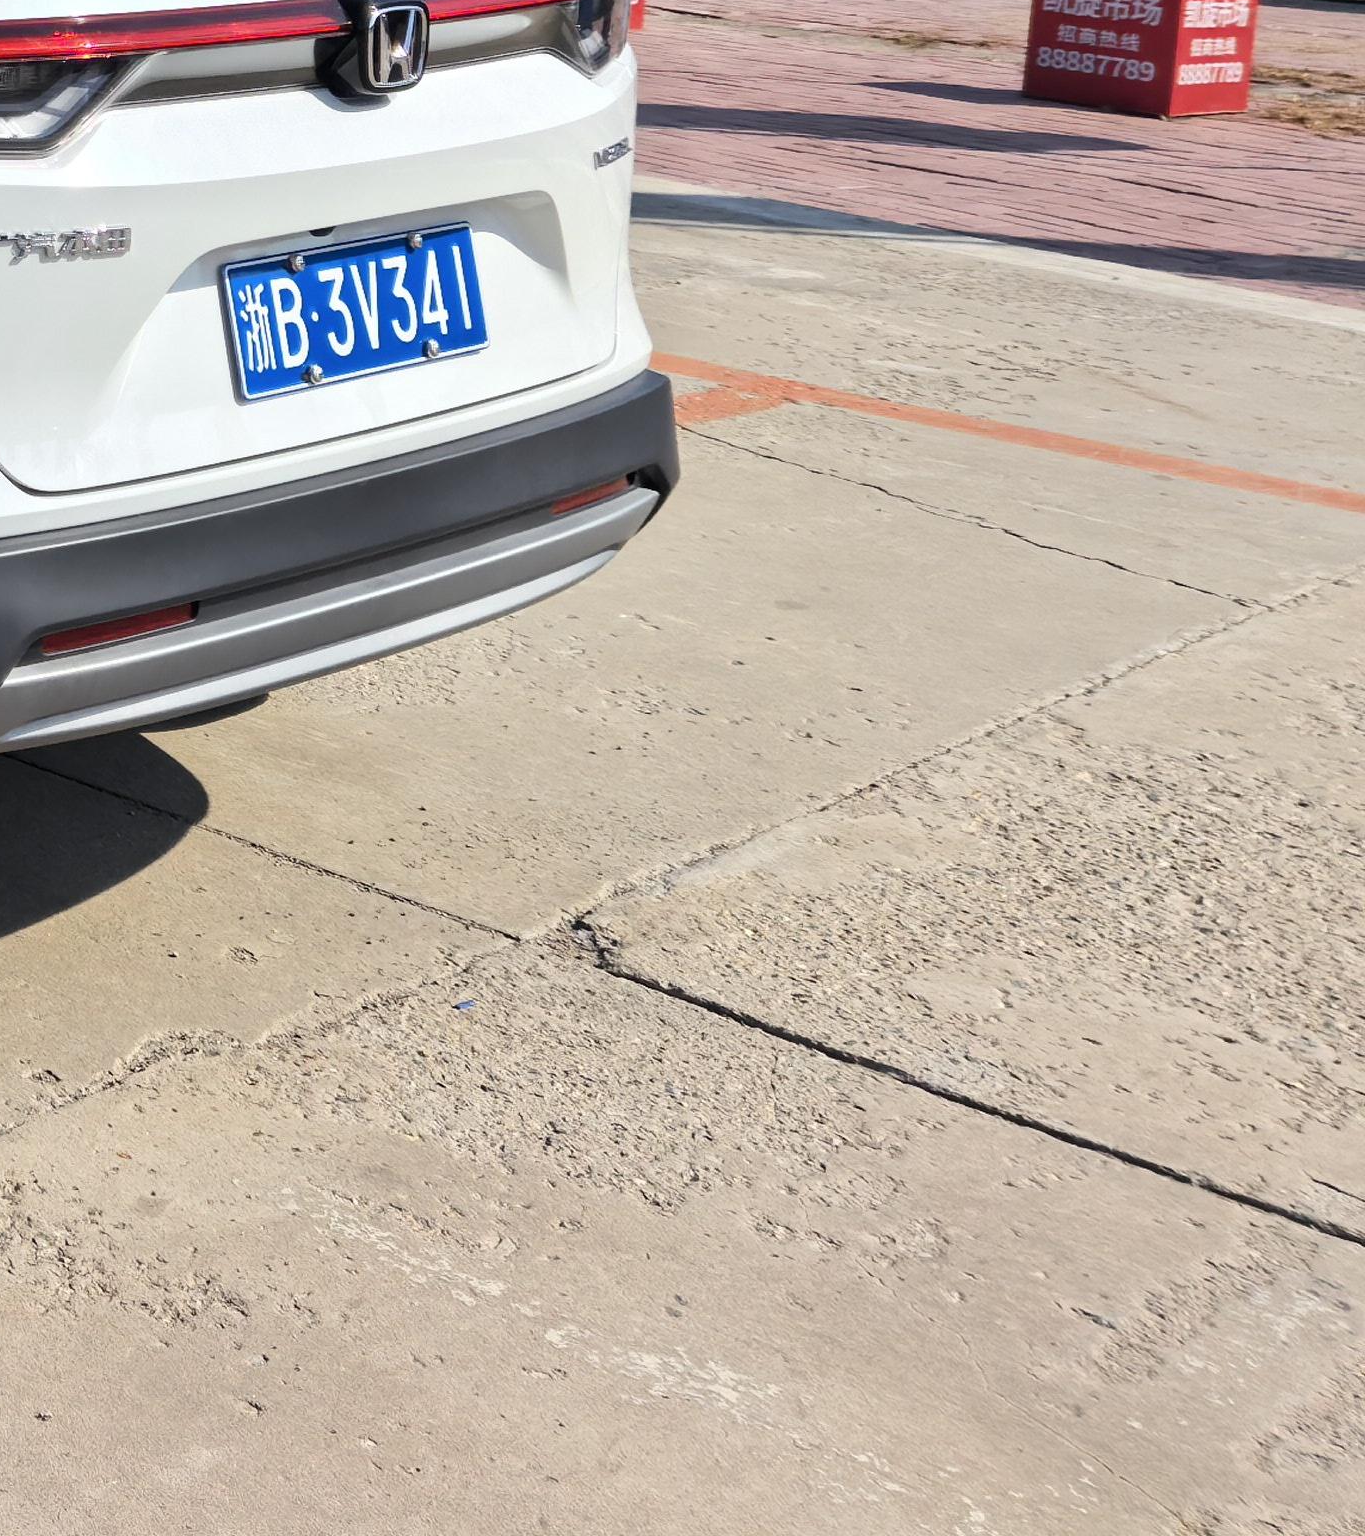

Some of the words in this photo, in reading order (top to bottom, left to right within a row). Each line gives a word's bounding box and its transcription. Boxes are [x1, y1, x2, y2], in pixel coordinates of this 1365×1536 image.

[1057, 24, 1140, 52] 招商热线
[1036, 46, 1156, 82] 88887789
